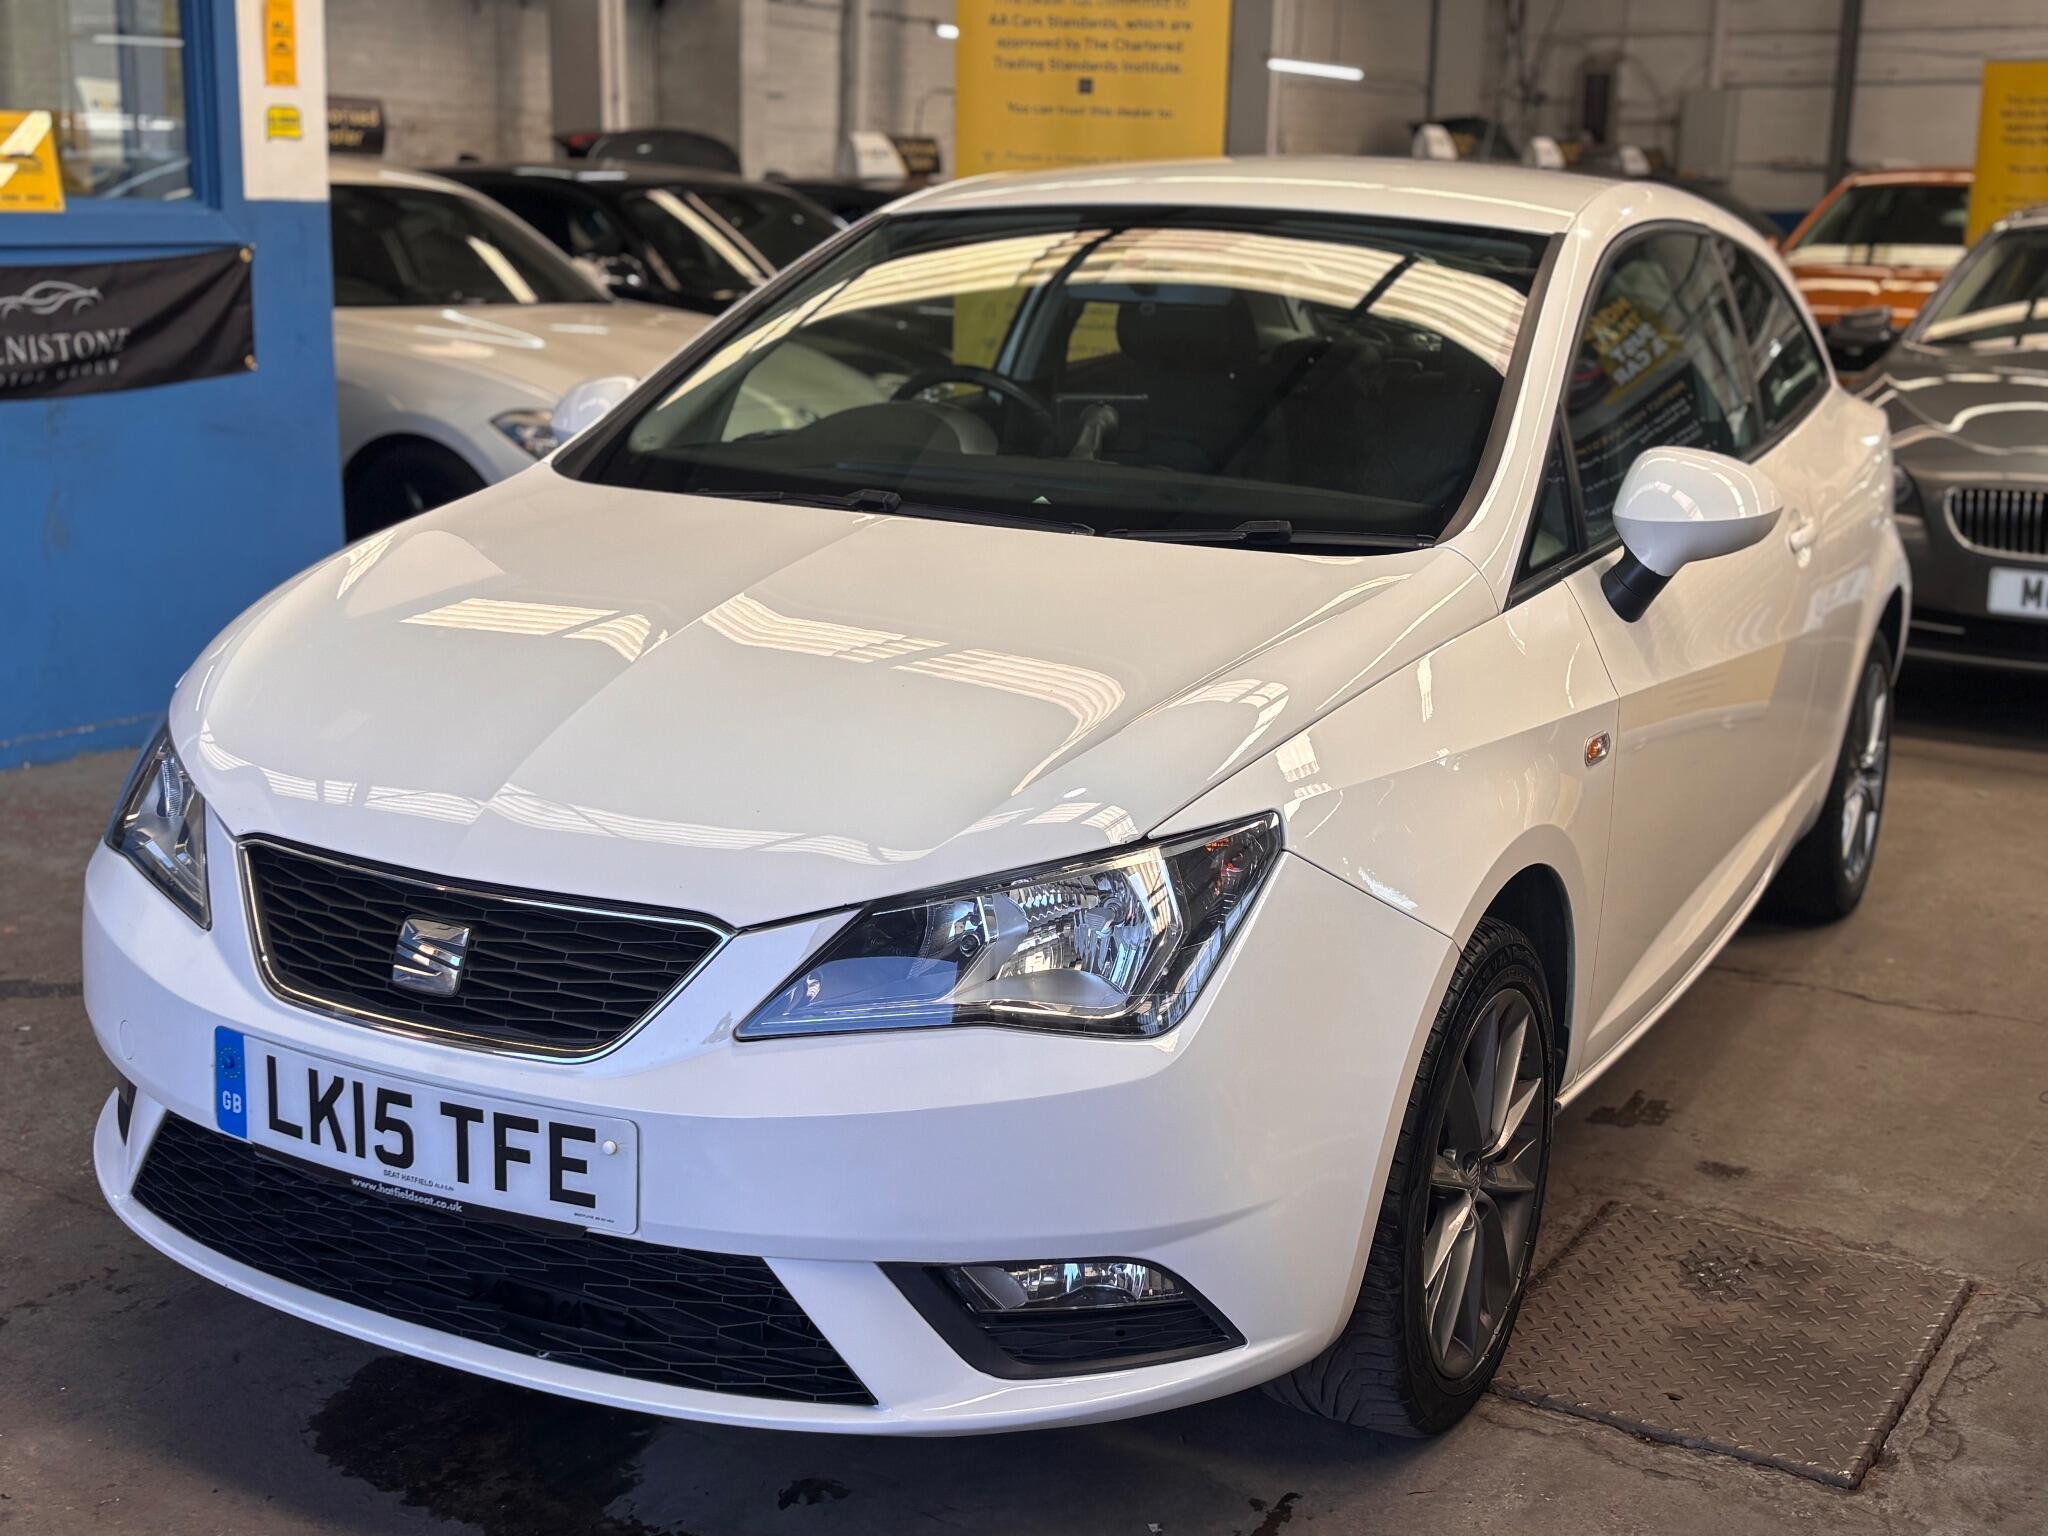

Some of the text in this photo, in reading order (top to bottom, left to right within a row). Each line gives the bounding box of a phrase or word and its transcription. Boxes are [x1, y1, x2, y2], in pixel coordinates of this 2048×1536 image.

[0, 327, 130, 365] NISTONE
[222, 1090, 242, 1114] GB
[266, 1054, 597, 1209] LK15 TFE
[351, 1178, 463, 1213] www.hatfieldseat.co.uk
